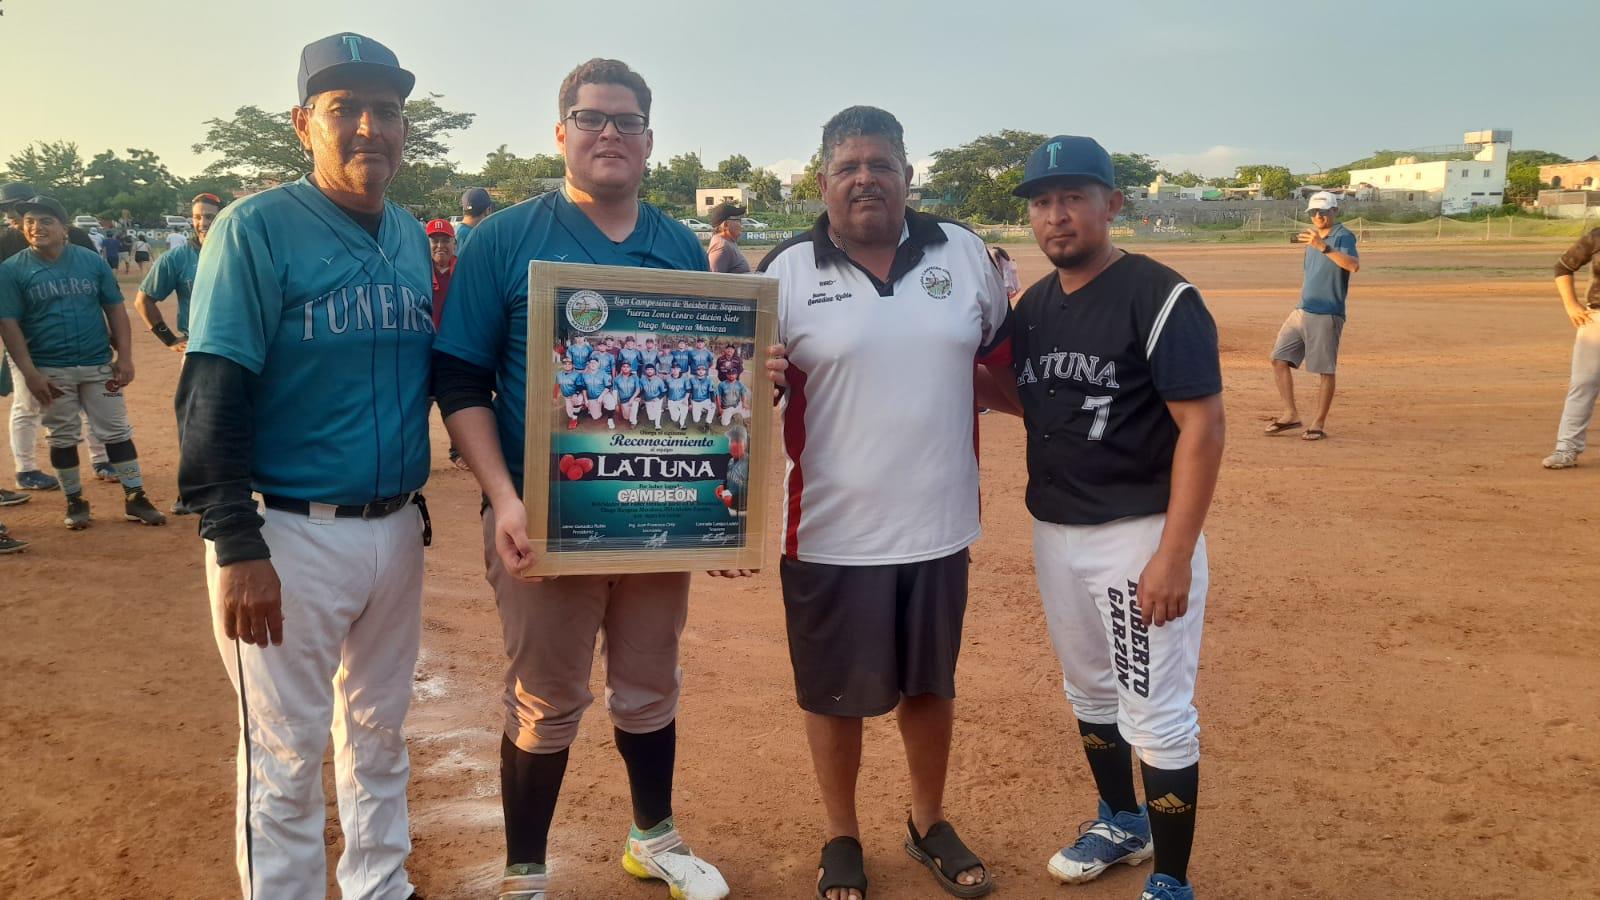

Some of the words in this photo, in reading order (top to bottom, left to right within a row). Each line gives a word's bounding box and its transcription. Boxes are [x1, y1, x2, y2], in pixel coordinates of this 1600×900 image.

[342, 35, 361, 62] T
[1046, 141, 1062, 169] T
[631, 298, 671, 307] Campesina
[626, 309, 650, 317] Fuerza
[652, 310, 670, 318] Zona
[671, 311, 694, 320] Centro
[723, 314, 740, 322] Siete
[638, 321, 659, 330] Diego
[695, 324, 727, 333] Mendoza
[1039, 351, 1120, 389] TUNA
[1081, 395, 1114, 441] 7
[610, 434, 714, 447] Reconocimiento
